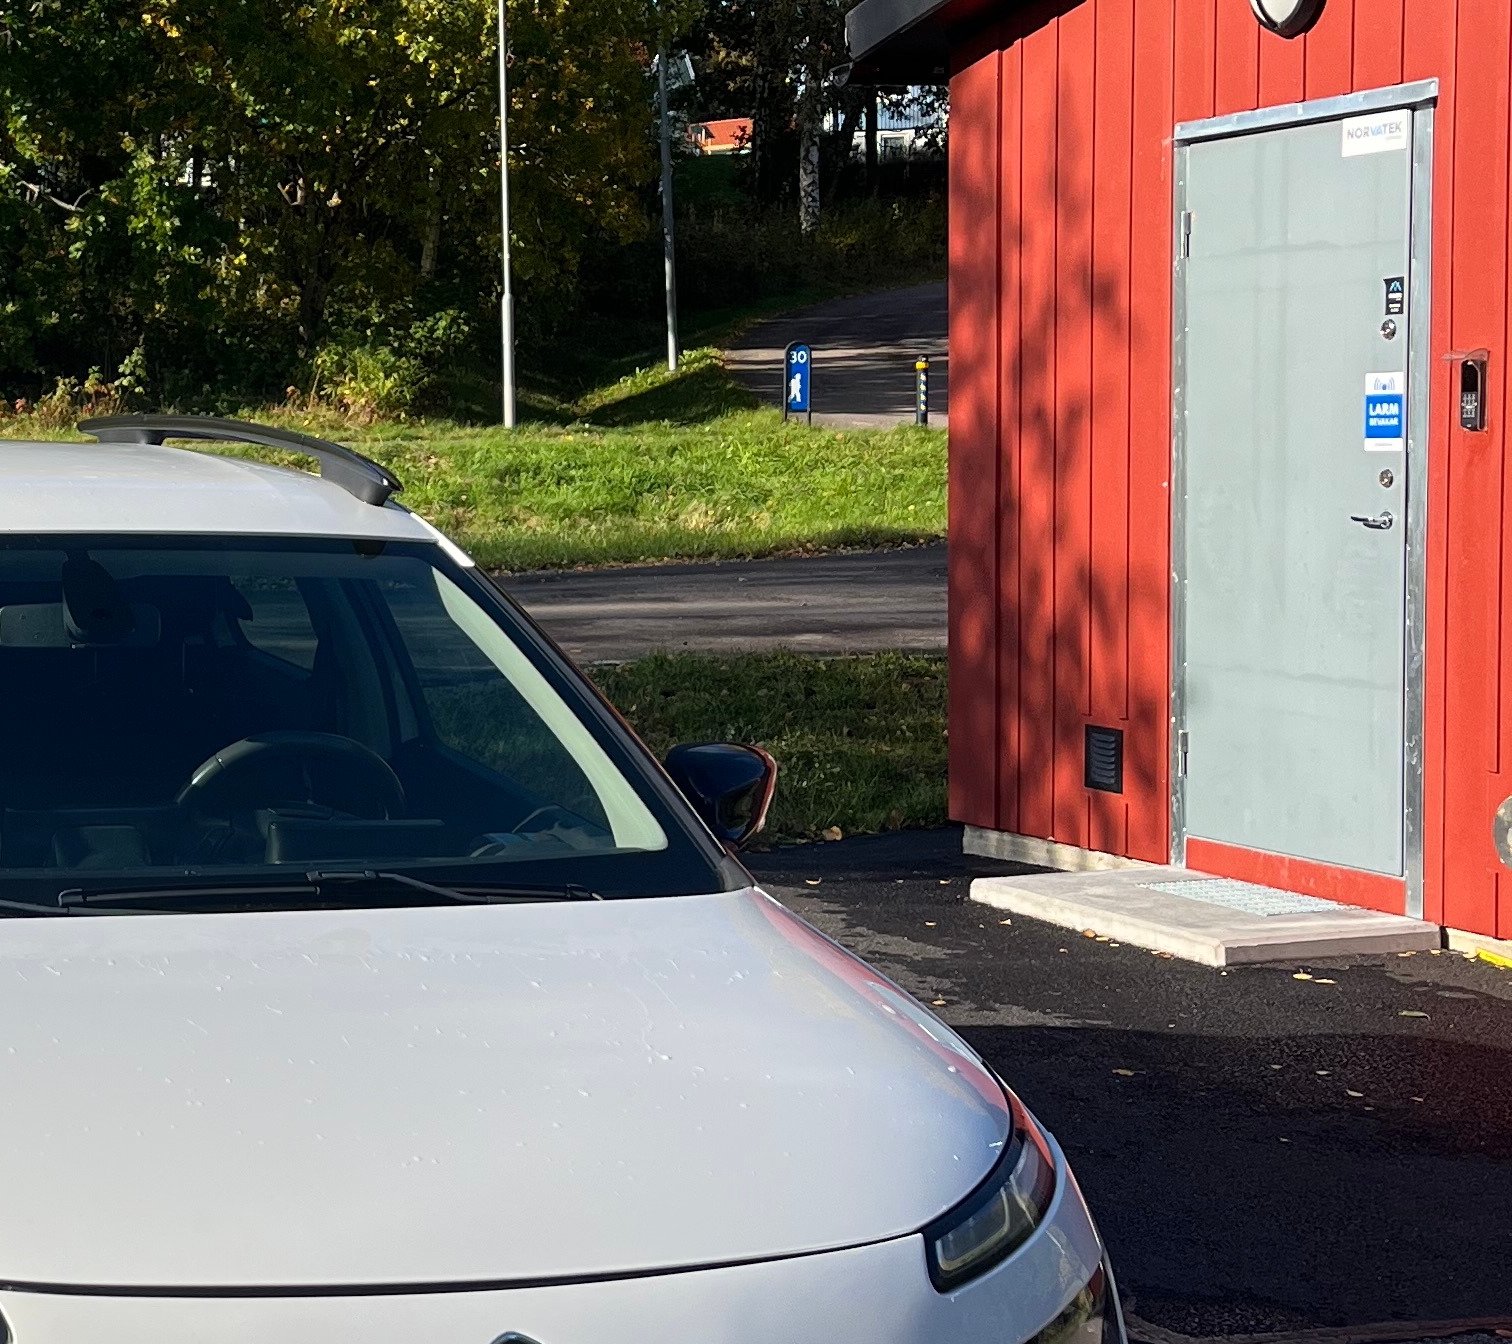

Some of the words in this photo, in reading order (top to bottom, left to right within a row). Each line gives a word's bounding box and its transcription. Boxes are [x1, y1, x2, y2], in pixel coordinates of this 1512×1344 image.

[1347, 121, 1402, 140] NORVATEK
[790, 351, 807, 364] 30
[1369, 403, 1399, 416] LARM
